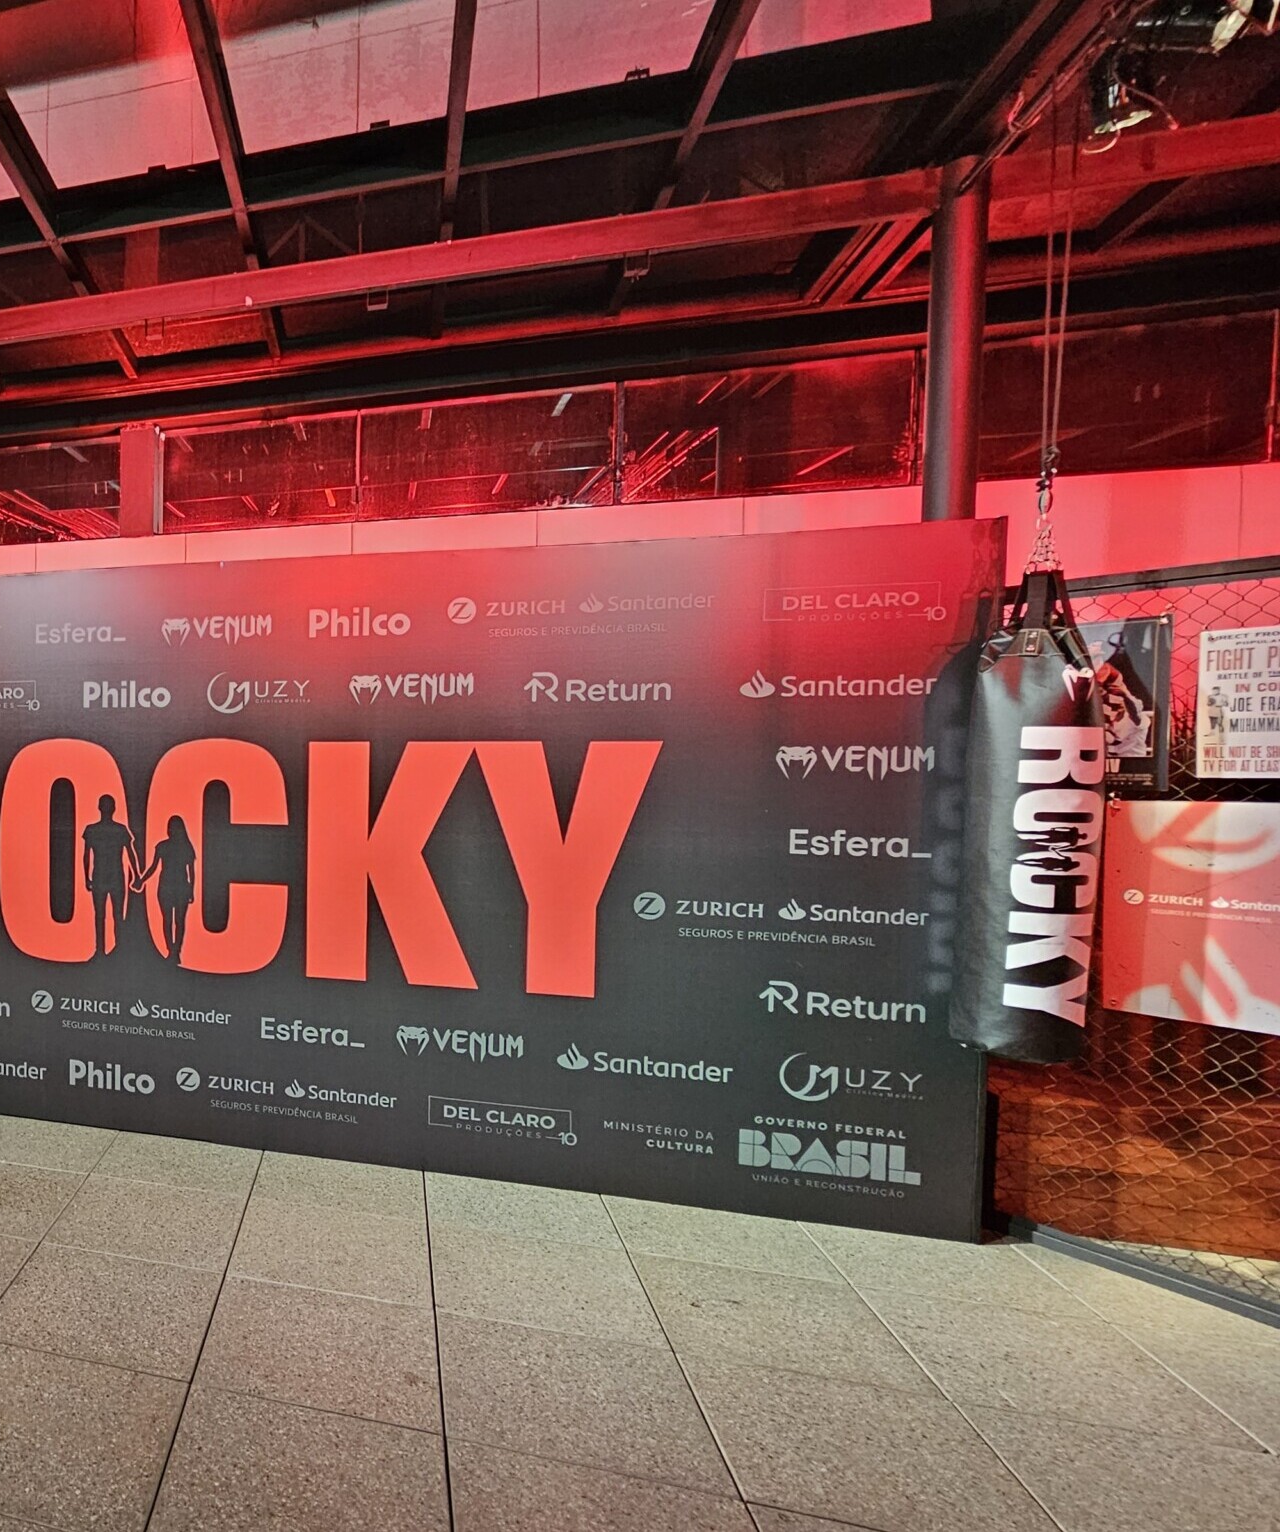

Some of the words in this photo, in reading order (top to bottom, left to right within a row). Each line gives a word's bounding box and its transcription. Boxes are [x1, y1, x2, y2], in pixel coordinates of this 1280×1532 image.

[486, 600, 566, 617] ZURICH
[608, 592, 715, 613] Santander
[782, 595, 828, 611] DEL
[835, 591, 920, 607] CLARO
[308, 606, 411, 638] Philco
[798, 610, 904, 622] PRODUÇÕES
[923, 606, 946, 621] 10
[193, 614, 272, 645] VENUM
[488, 626, 538, 638] SEGUROS
[541, 626, 548, 636] E
[627, 622, 667, 633] BRASIL
[1206, 647, 1255, 672] FIGHT
[1267, 646, 1280, 668] P
[385, 672, 474, 705] VENUM
[781, 674, 937, 698] Santander
[1217, 672, 1249, 680] BATTLE
[1235, 683, 1251, 693] IN
[1257, 682, 1280, 692] CO
[82, 680, 171, 708] Philco
[566, 679, 671, 702] Return
[26, 700, 40, 711] 10
[1230, 697, 1253, 712] JOE
[1229, 717, 1280, 733] MUHAMMA
[822, 745, 935, 781] VENUM
[1203, 746, 1225, 758] WILL
[1229, 746, 1246, 758] NOT
[1250, 745, 1262, 758] BE
[1218, 760, 1236, 772] FOR
[1240, 760, 1251, 772] AT
[1003, 726, 1104, 1028] ROCKY
[676, 900, 764, 919] ZURICH
[810, 903, 930, 926] Santander
[1148, 893, 1204, 906] ZURICH
[1231, 899, 1280, 912] Santan
[678, 927, 733, 939] SEGUROS
[737, 930, 744, 939] E
[748, 930, 828, 944] PREVIDÊNCIA
[831, 935, 875, 947] BRASIL
[60, 997, 120, 1015] ZURICH
[151, 1004, 232, 1025] Santander
[807, 991, 926, 1024] Return
[61, 1020, 100, 1031] SEGUROS
[102, 1023, 107, 1031] E
[166, 1030, 196, 1041] BRASIL
[433, 1026, 524, 1063] VENUM
[69, 1058, 156, 1095] Philco
[593, 1050, 733, 1083] Santander
[208, 1075, 274, 1095] ZURICH
[308, 1084, 397, 1109] Santander
[210, 1099, 252, 1112] SEGUROS
[254, 1104, 260, 1113] E
[262, 1104, 323, 1120] PREVIDÊNCIA
[325, 1111, 358, 1124] BRASIL
[443, 1104, 480, 1122] DEL
[486, 1109, 556, 1130] CLARO
[455, 1122, 542, 1139] PRODUÇÕES
[558, 1132, 577, 1146] 10
[603, 1119, 689, 1138] MINISTÉRIO
[695, 1130, 714, 1141] DA
[754, 1115, 828, 1131] GOVERNO
[835, 1123, 907, 1140] FEDERAL
[646, 1139, 714, 1155] CULTURA
[738, 1128, 921, 1186] BRASIL
[752, 1172, 789, 1186] UNIÃO
[794, 1178, 801, 1187] E
[806, 1178, 905, 1199] RECONSTRUÇÃO
